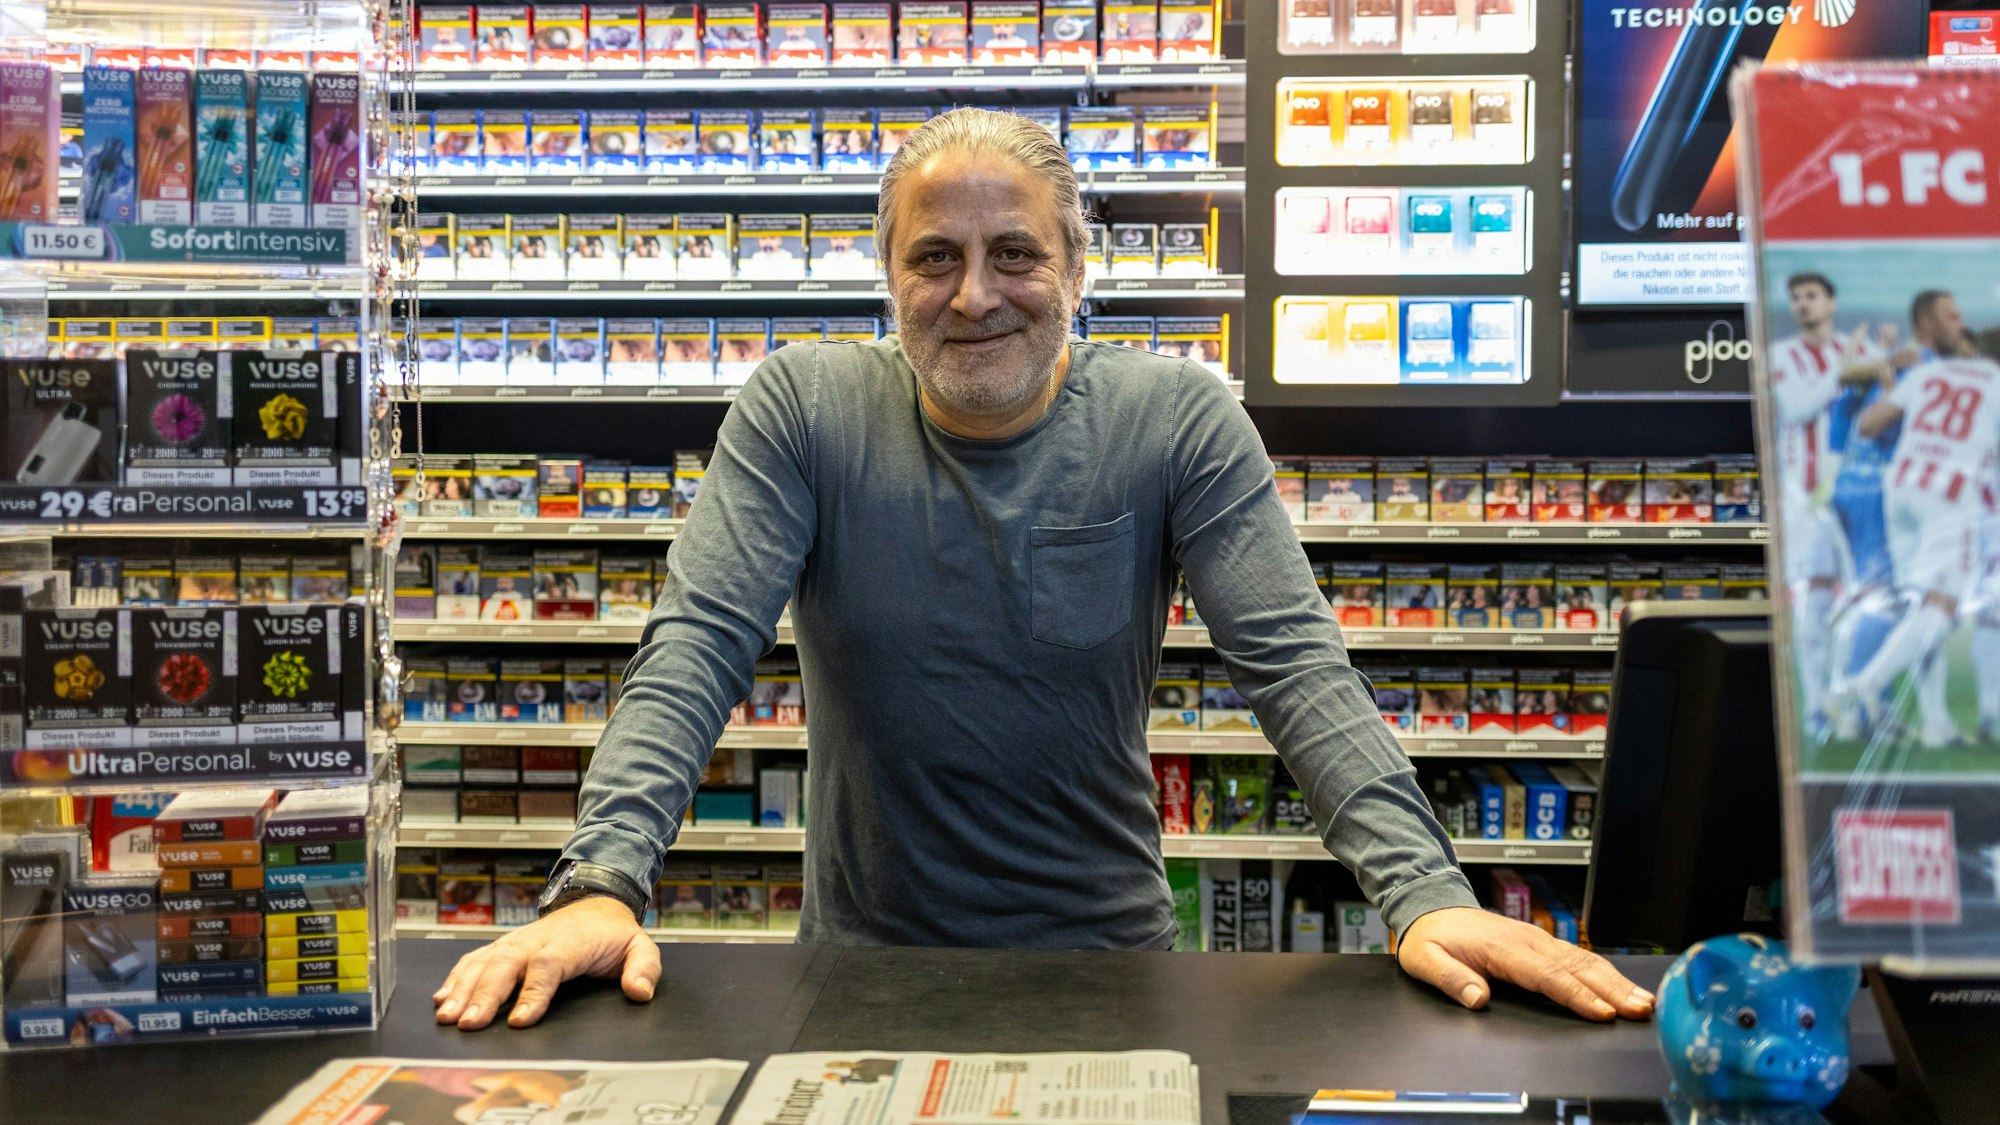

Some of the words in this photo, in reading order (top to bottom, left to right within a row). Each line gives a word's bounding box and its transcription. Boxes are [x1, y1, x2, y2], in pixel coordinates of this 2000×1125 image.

[1611, 7, 1803, 28] TECHNOLOGY
[1944, 57, 1998, 66] Rauchen
[1292, 96, 1321, 109] evo
[1352, 96, 1379, 109] evo
[1415, 95, 1442, 108] evo
[1477, 94, 1505, 108] evo
[86, 107, 130, 116] NICOTINE
[1830, 152, 1891, 208] 1.
[1902, 150, 1988, 208] FC
[1416, 203, 1443, 216] evo
[1657, 212, 1701, 229] Mehr
[1705, 212, 1734, 229] auf
[30, 233, 80, 249] 11.50
[84, 233, 96, 249] €
[150, 228, 340, 252] SofortIntensiv.
[1601, 251, 1634, 262] Dieses
[1637, 251, 1674, 262] Produkt
[1678, 251, 1690, 262] ist
[1693, 251, 1718, 262] nicht
[1613, 268, 1628, 279] die
[1632, 268, 1671, 279] rauchen
[1675, 268, 1697, 278] oder
[1700, 267, 1734, 278] andere
[1643, 284, 1679, 295] Nikotin
[1682, 284, 1695, 295] ist
[1697, 284, 1713, 295] ein
[1686, 319, 1753, 384] ploo
[36, 390, 73, 398] ULTRA
[1912, 376, 1982, 441] 28
[142, 471, 174, 479] Dieses
[178, 471, 215, 479] Produkt
[249, 470, 282, 479] Dieses
[284, 470, 320, 479] Produkt
[40, 490, 85, 518] 29
[88, 490, 113, 518] €
[1348, 527, 1380, 538] ploom
[1427, 527, 1460, 538] ploom
[1507, 527, 1540, 538] ploom
[1587, 528, 1621, 539] ploom
[1667, 528, 1702, 539] ploom
[1432, 633, 1464, 644] ploom
[42, 731, 74, 740] Dieses
[77, 731, 116, 739] Produkt
[148, 730, 180, 738] Dieses
[183, 729, 221, 738] Produkt
[253, 726, 285, 734] Dieses
[288, 725, 324, 733] Produkt
[68, 748, 256, 775] UltraPersonal.
[269, 751, 284, 763] by
[1487, 798, 1500, 836] OCB
[1536, 792, 1556, 840] OCB
[1572, 795, 1592, 839] OCB
[1244, 878, 1270, 898] 50
[193, 1007, 315, 1025] EinfachBesser.
[141, 1018, 168, 1029] 11.95
[170, 1019, 177, 1028] €
[23, 1025, 49, 1035] 9.95
